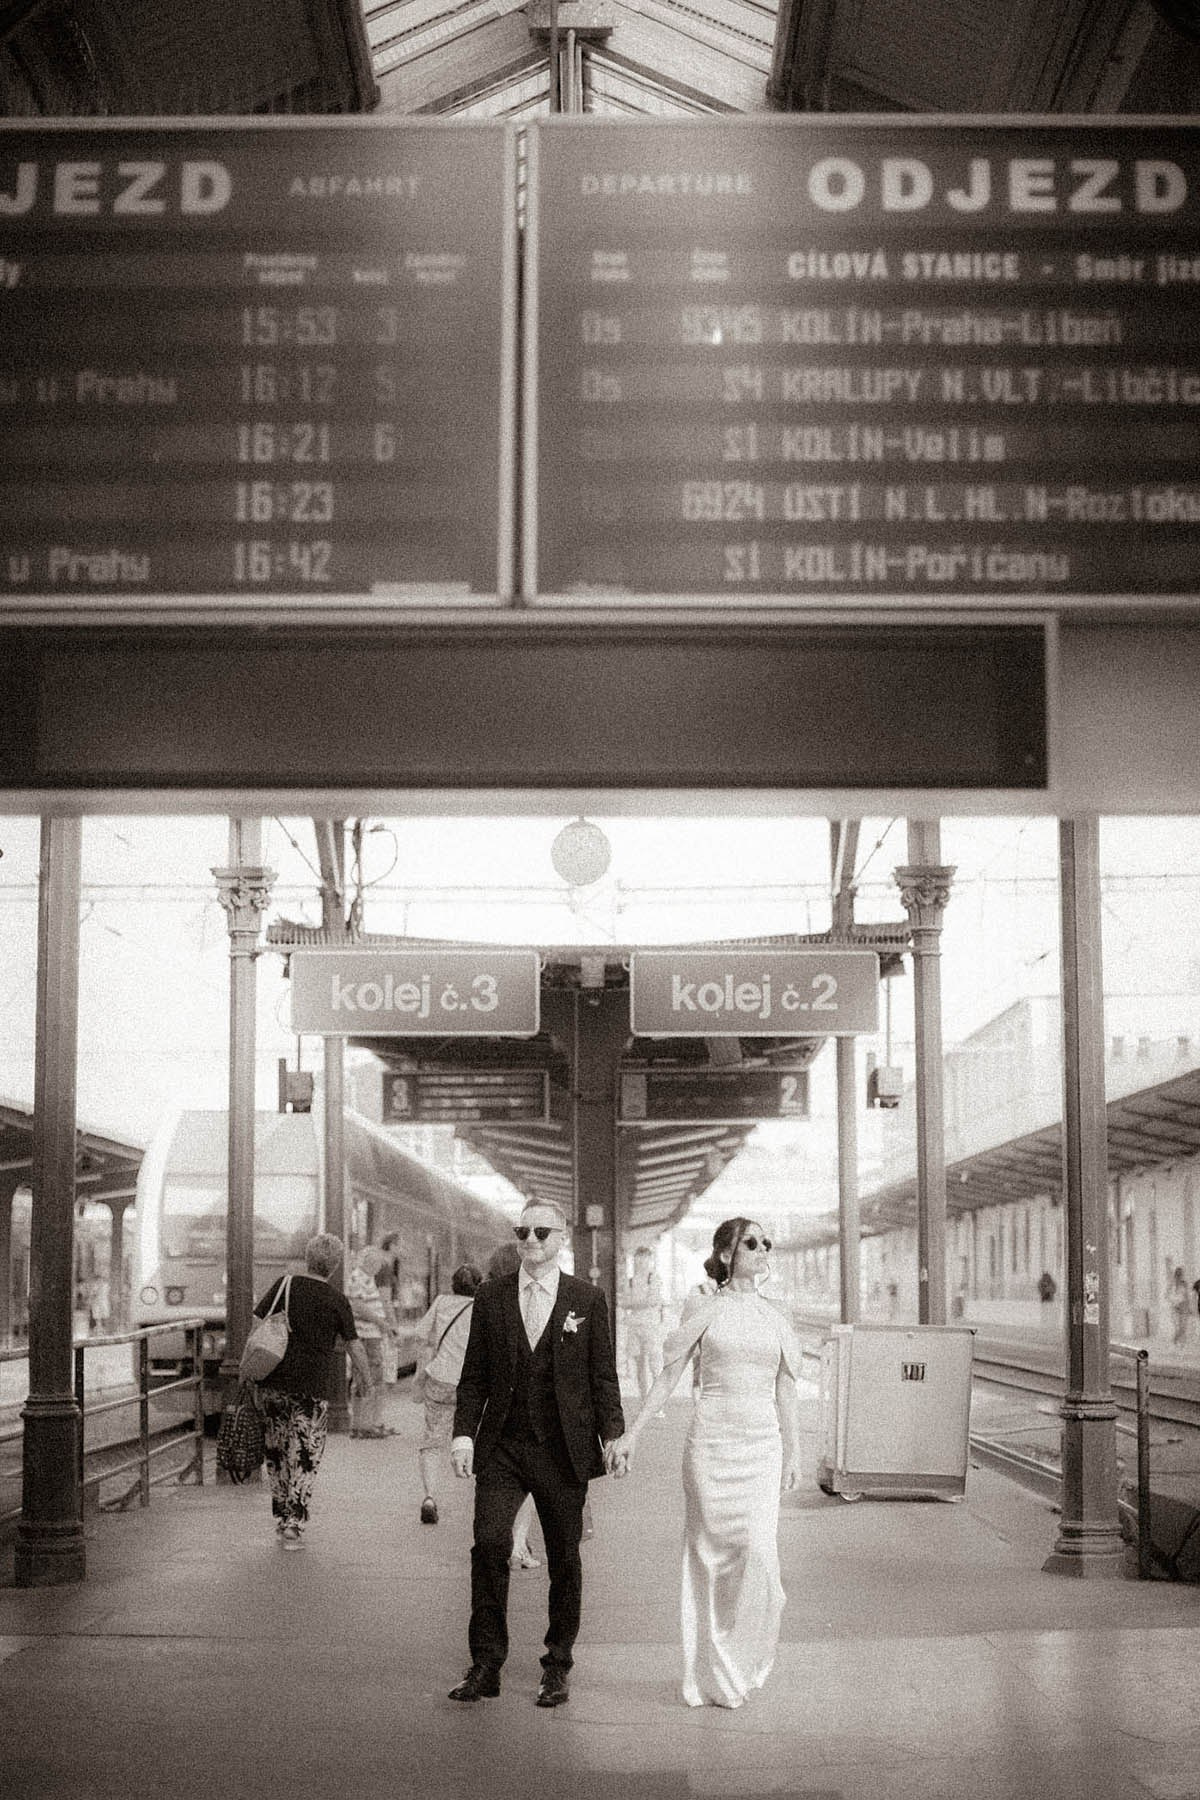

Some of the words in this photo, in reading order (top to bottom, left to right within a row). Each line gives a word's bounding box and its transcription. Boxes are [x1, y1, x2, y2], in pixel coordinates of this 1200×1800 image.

[582, 172, 754, 198] DEPARTURE
[807, 157, 1188, 213] ODJEZD
[786, 249, 889, 281] CÍLOVÁ
[902, 251, 1020, 282] STANICE
[242, 307, 338, 345] 15:53
[782, 367, 921, 402] KRALUPY
[238, 423, 331, 463] 16:21
[374, 422, 396, 462] 6
[235, 481, 334, 522] 16:23
[682, 479, 764, 522] 6924
[232, 540, 333, 582] 16:42
[331, 974, 432, 1019] kolej
[440, 973, 499, 1012] č.3
[672, 973, 773, 1020] kolej
[781, 973, 839, 1012] č.2
[780, 1074, 799, 1108] 2
